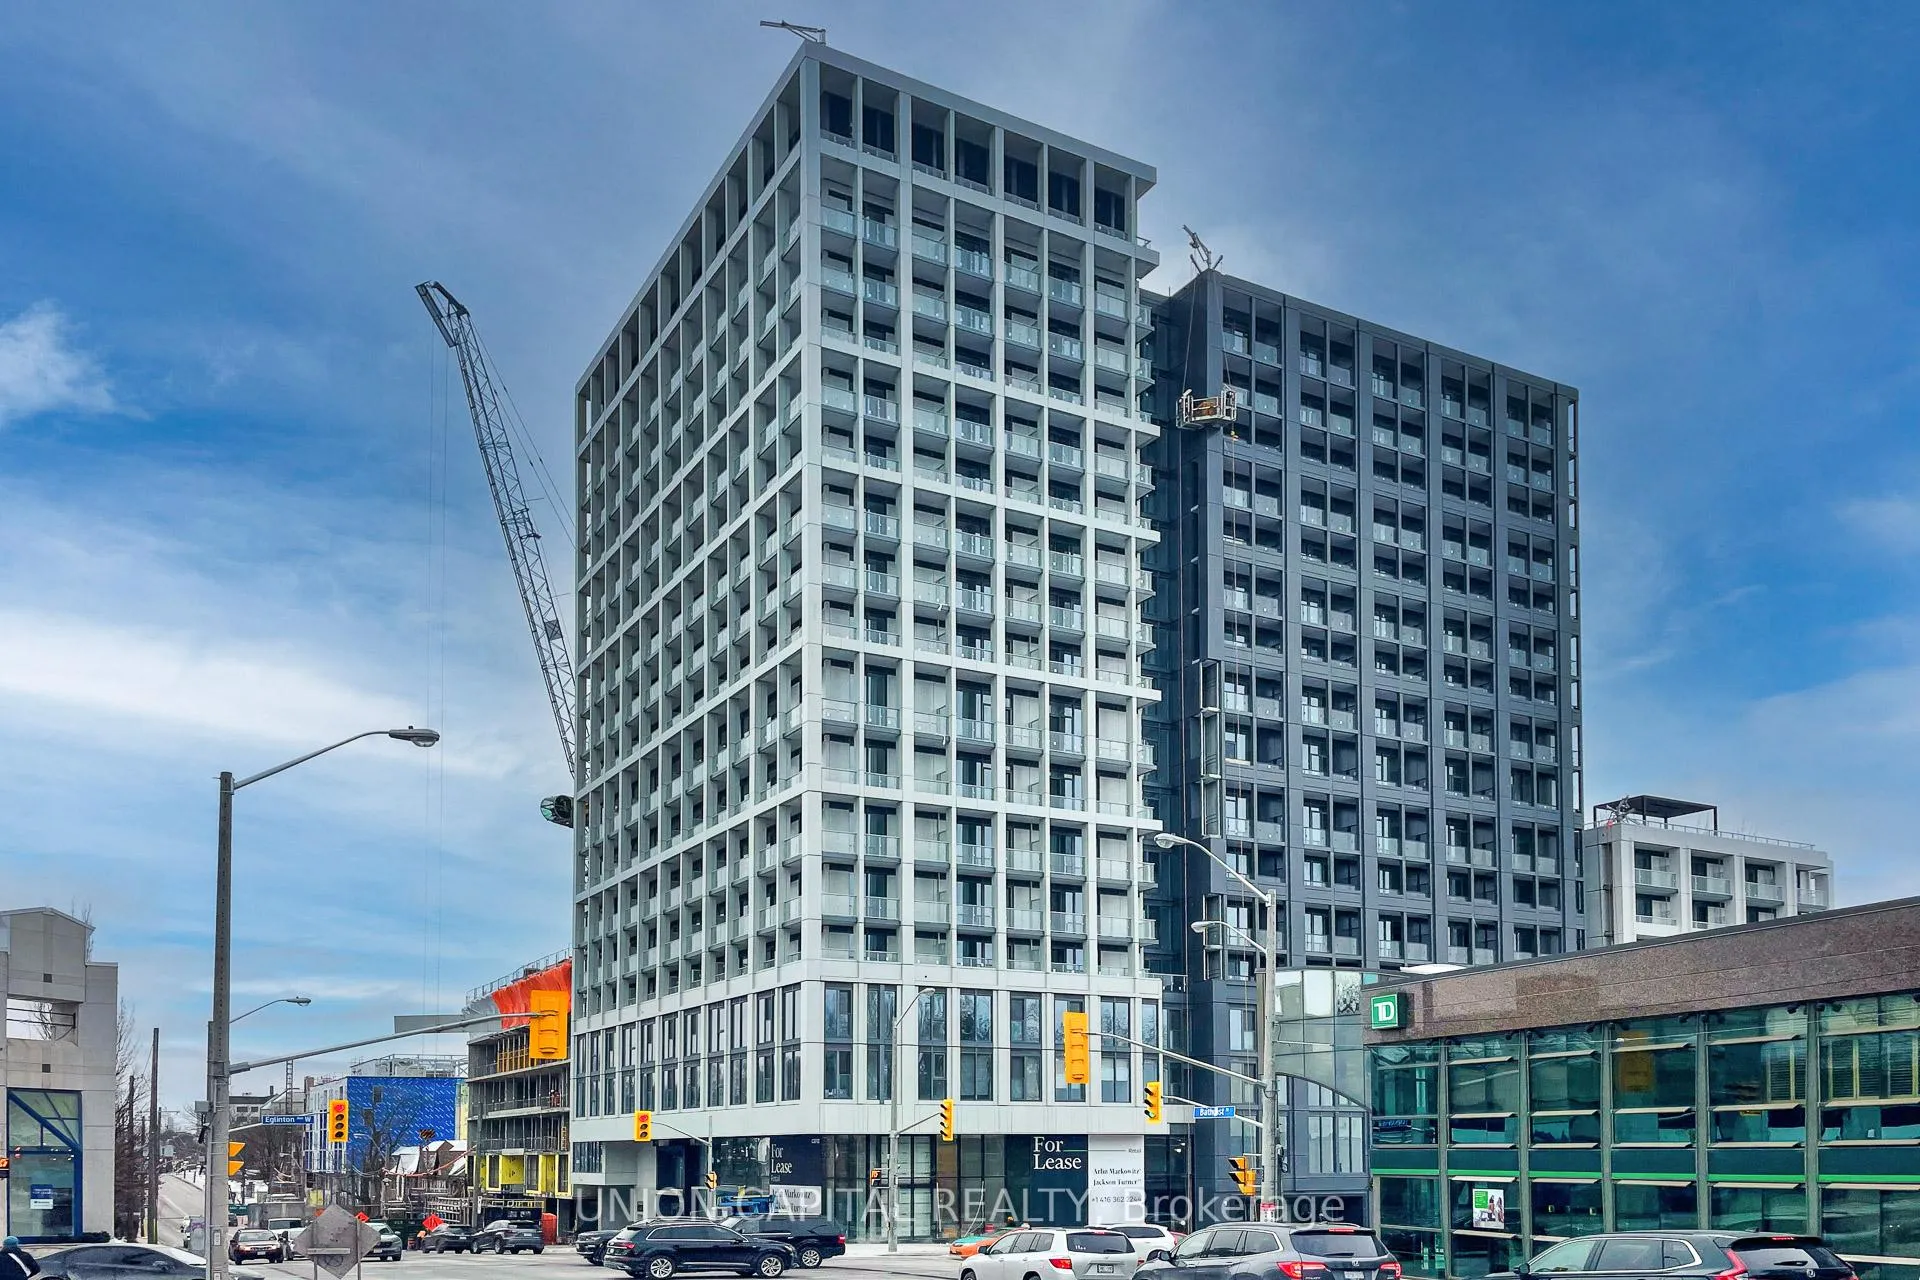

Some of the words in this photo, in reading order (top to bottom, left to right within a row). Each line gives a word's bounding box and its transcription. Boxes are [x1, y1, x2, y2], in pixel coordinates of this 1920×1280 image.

[1374, 1001, 1395, 1021] TD
[265, 1116, 296, 1124] Eglinton
[771, 1143, 784, 1158] For
[1033, 1136, 1064, 1153] For
[771, 1159, 792, 1174] Lease
[1033, 1153, 1082, 1170] Lease
